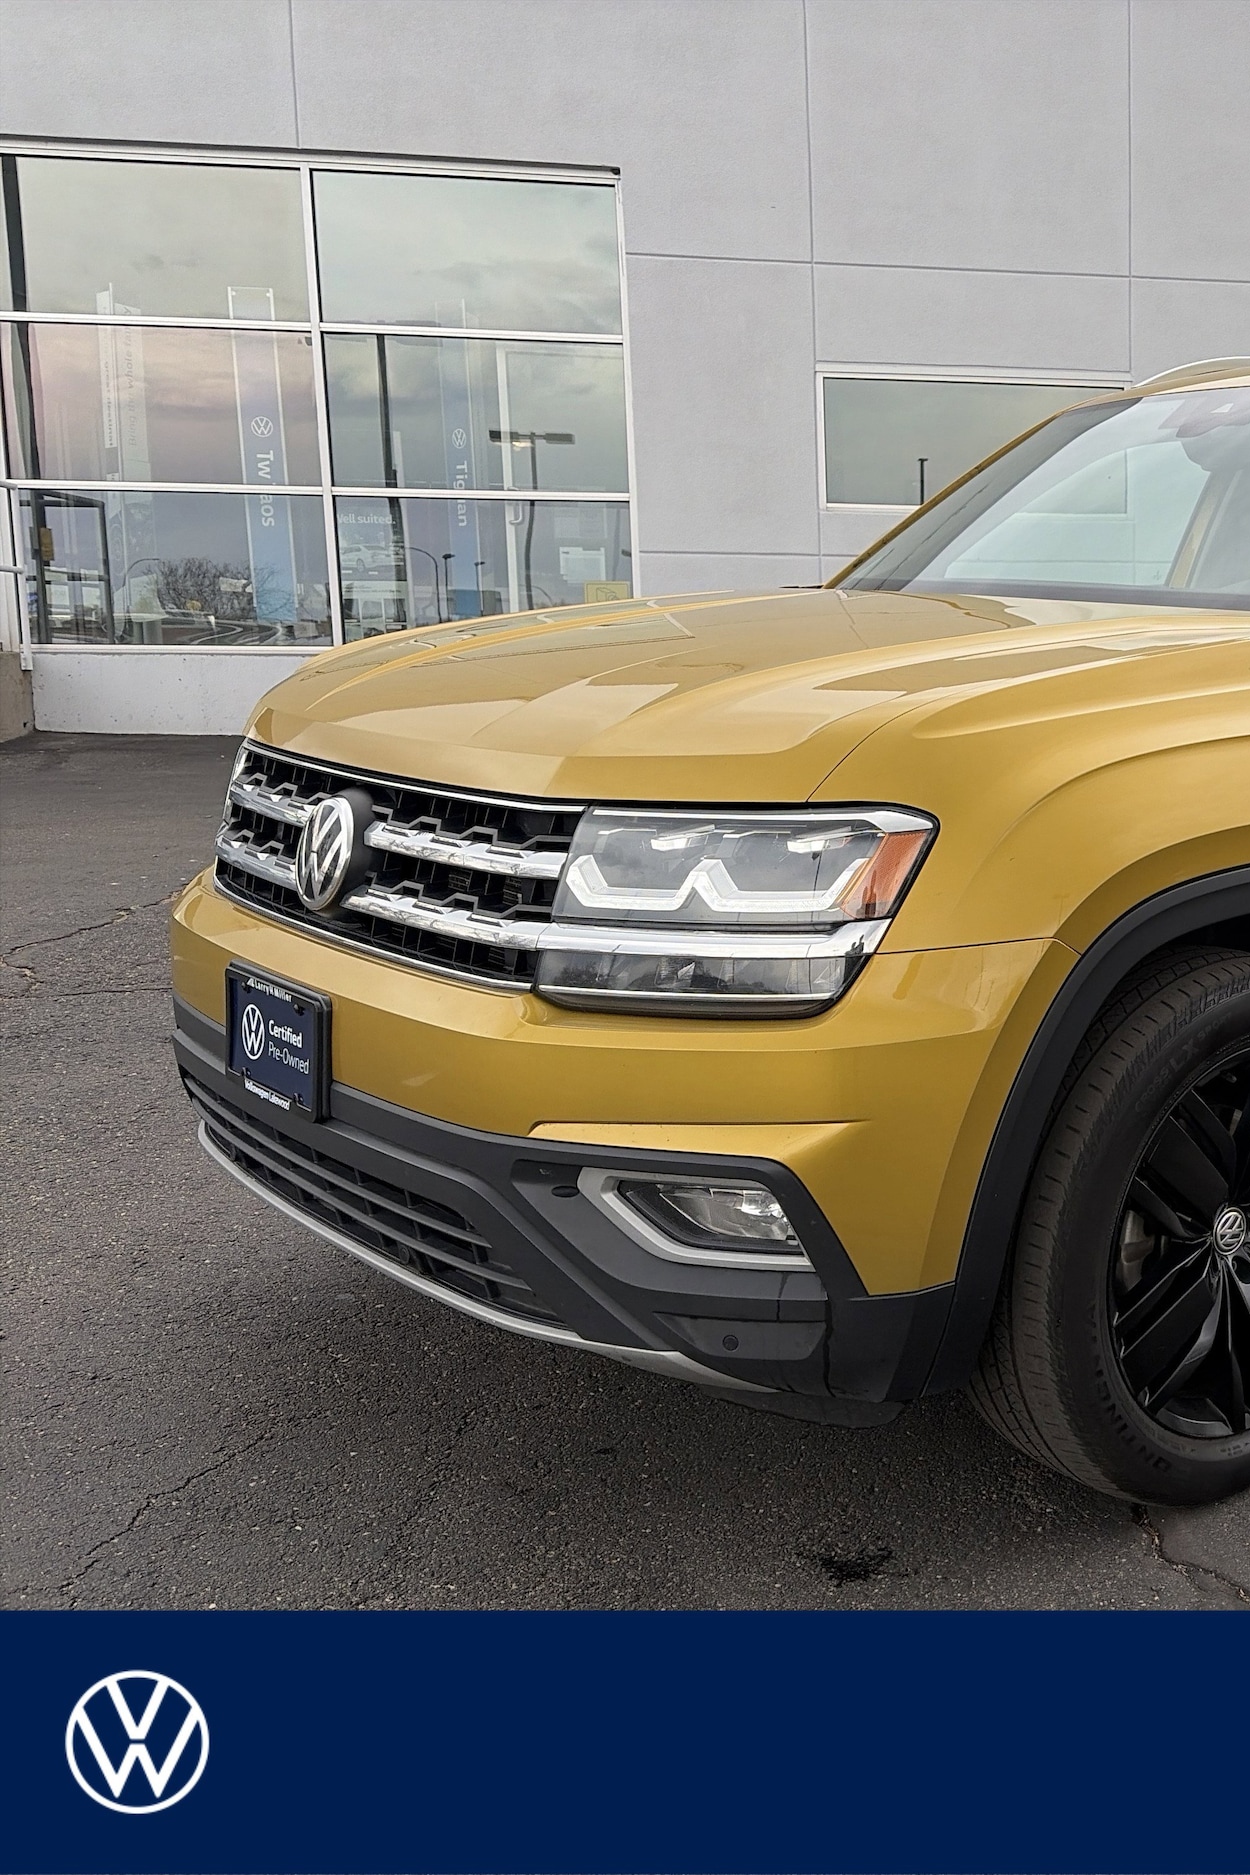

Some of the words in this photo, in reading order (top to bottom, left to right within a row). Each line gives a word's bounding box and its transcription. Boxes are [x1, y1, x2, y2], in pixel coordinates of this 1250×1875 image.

[357, 513, 396, 524] suited.
[268, 1019, 303, 1049] Certified
[268, 1040, 310, 1075] Pre-Owned
